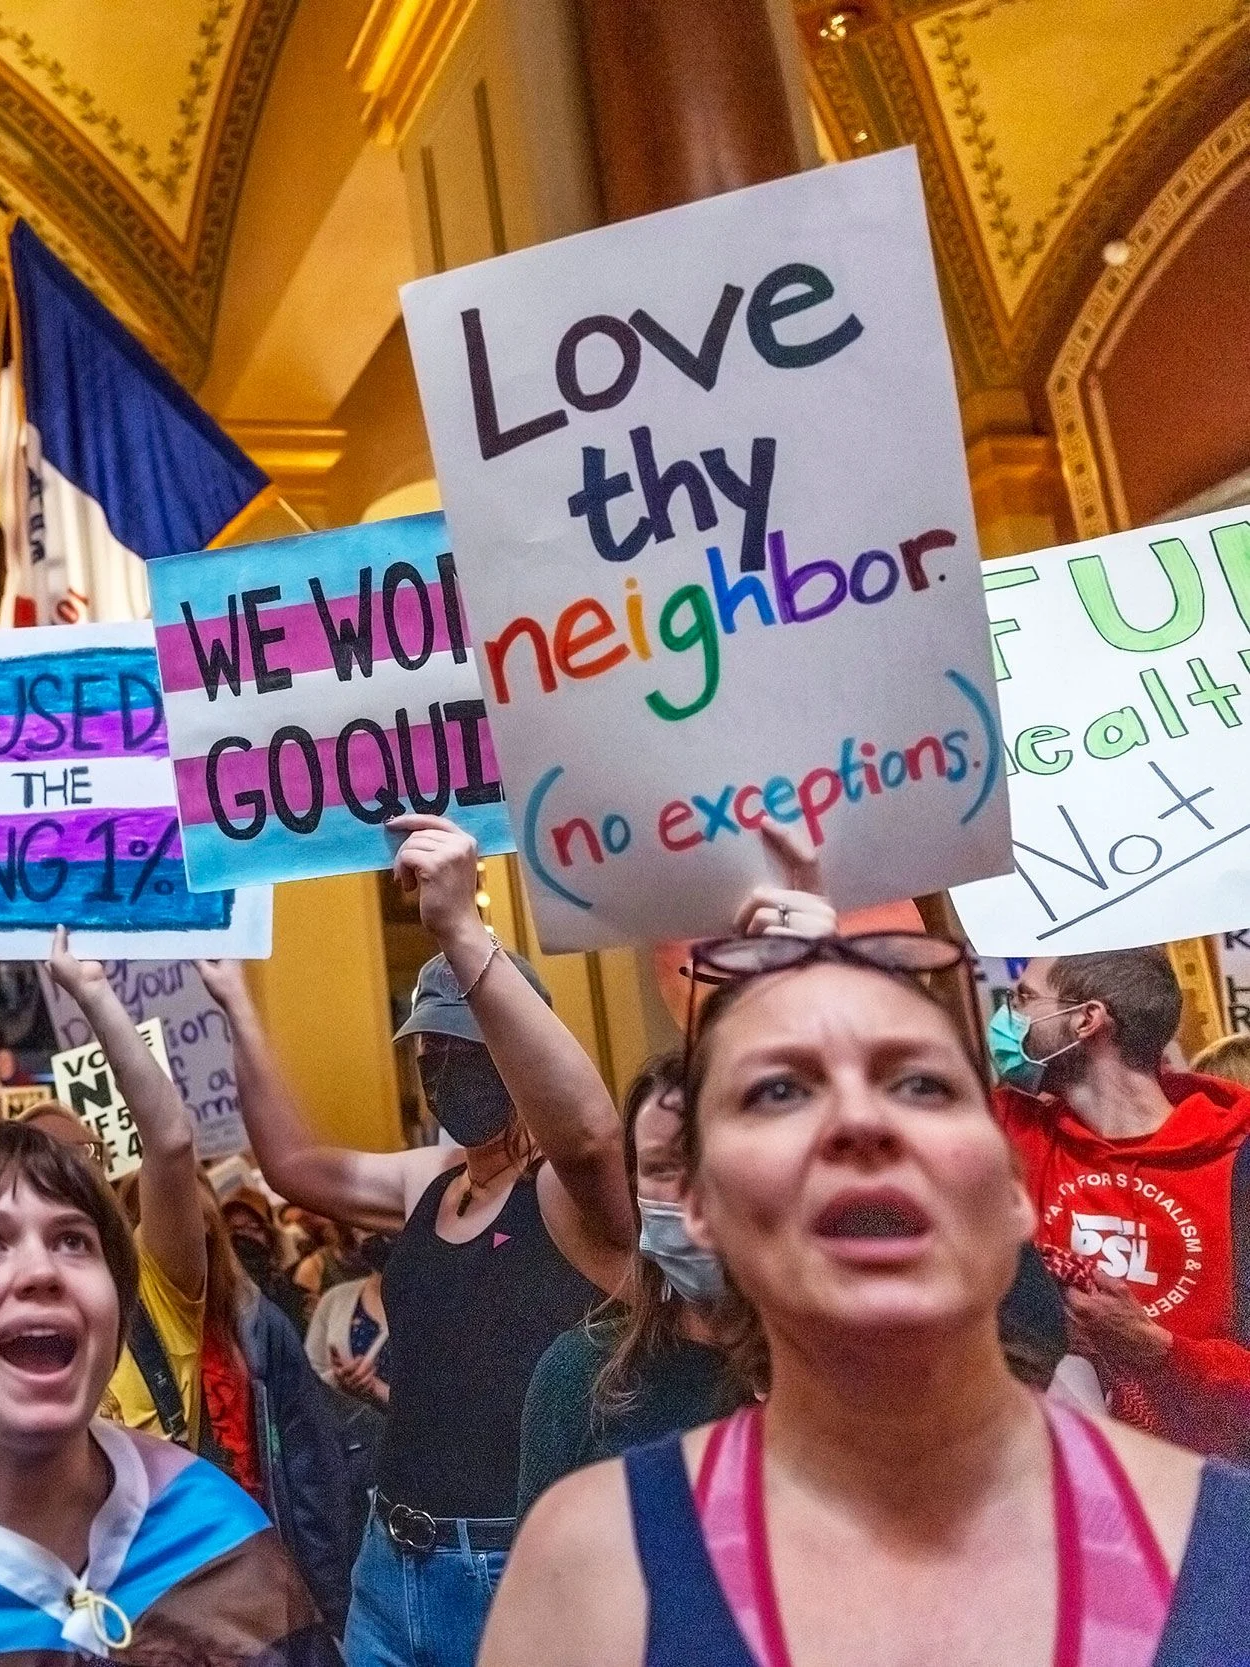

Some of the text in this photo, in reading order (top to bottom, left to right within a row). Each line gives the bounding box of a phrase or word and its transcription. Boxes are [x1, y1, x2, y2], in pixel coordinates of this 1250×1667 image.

[460, 262, 865, 461] Love
[567, 425, 777, 574] thy
[179, 584, 294, 702] WE
[484, 529, 958, 722] neighbor.
[205, 698, 506, 841] GO QUI
[1003, 649, 1250, 777] ealt
[11, 765, 93, 810] THE
[523, 668, 1002, 910] (no exceptions.)
[1011, 761, 1215, 923] Not
[79, 814, 179, 907] 1%
[1076, 1172, 1113, 1189] FOR
[1142, 1275, 1197, 1318] LIBER
[1184, 1258, 1203, 1272] &
